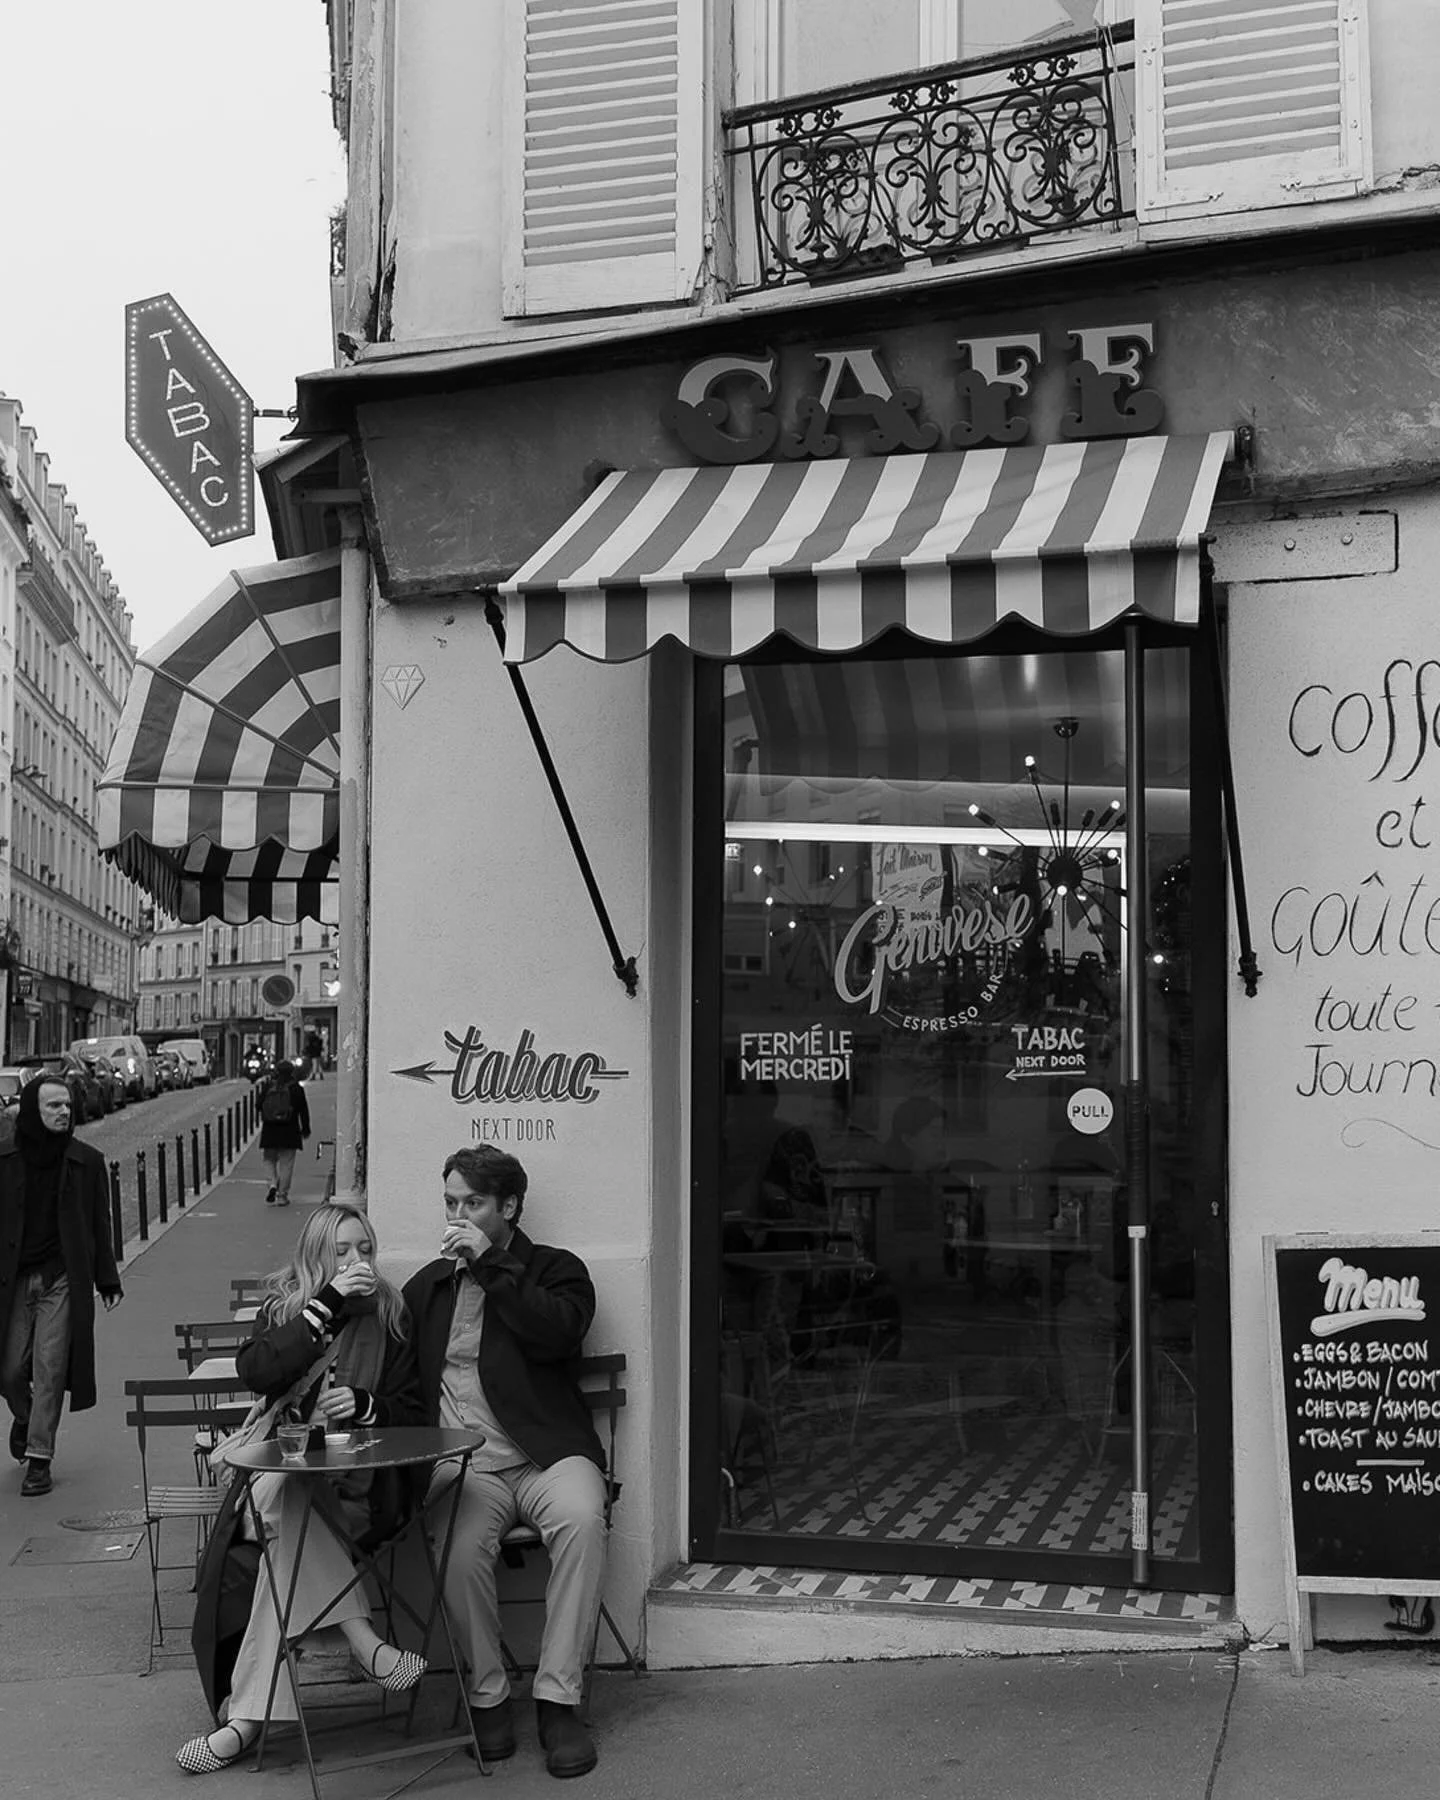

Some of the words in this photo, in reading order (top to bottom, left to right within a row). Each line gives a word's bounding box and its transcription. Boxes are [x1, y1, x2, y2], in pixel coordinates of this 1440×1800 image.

[660, 321, 1166, 465] CAFE
[148, 329, 230, 508] TABAC
[1377, 797, 1430, 848] et
[833, 893, 1036, 1015] Genovese
[902, 1005, 980, 1032] ESPRESSO
[979, 972, 1004, 1003] BAR
[1315, 984, 1417, 1032] toute
[741, 1023, 824, 1056] FERMÉ
[829, 1030, 854, 1055] LE
[1012, 1024, 1085, 1050] TABAC
[443, 1025, 606, 1104] tabac
[1016, 1056, 1045, 1070] NEXT
[1050, 1053, 1087, 1068] DOOR
[1297, 1044, 1440, 1097] Journ
[471, 1117, 512, 1141] NEXT
[516, 1118, 557, 1142] DOOR
[1071, 1105, 1109, 1119] PULL
[1318, 1257, 1426, 1313] Menu
[1366, 1339, 1430, 1364] BACON
[1304, 1367, 1381, 1393] JAMBON
[1305, 1427, 1371, 1451] TOAST
[1375, 1430, 1398, 1451] AU
[1402, 1426, 1440, 1449] SAU
[1314, 1470, 1373, 1495] CAKES
